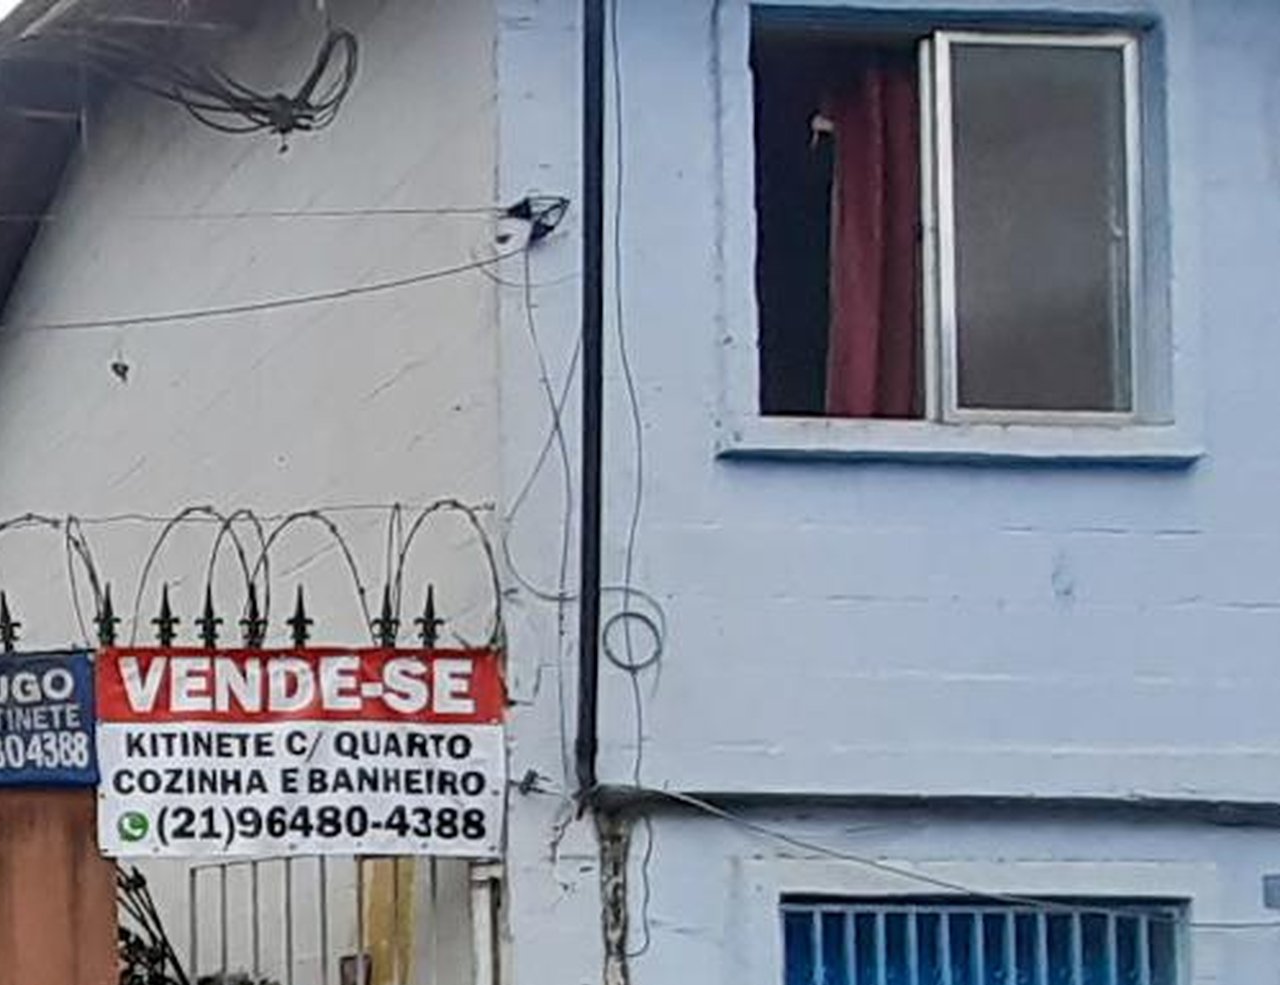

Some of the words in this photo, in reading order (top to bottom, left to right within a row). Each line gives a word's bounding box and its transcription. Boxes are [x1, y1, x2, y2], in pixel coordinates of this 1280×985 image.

[117, 655, 476, 715] VENDE-SE
[126, 730, 275, 758] KITINETE
[285, 730, 324, 763] C/
[333, 731, 472, 760] QUARTO
[112, 768, 269, 796] COZINHA
[280, 768, 300, 794] E
[307, 767, 487, 797] BANHEIRO
[156, 804, 487, 850] (21)96480-4388
